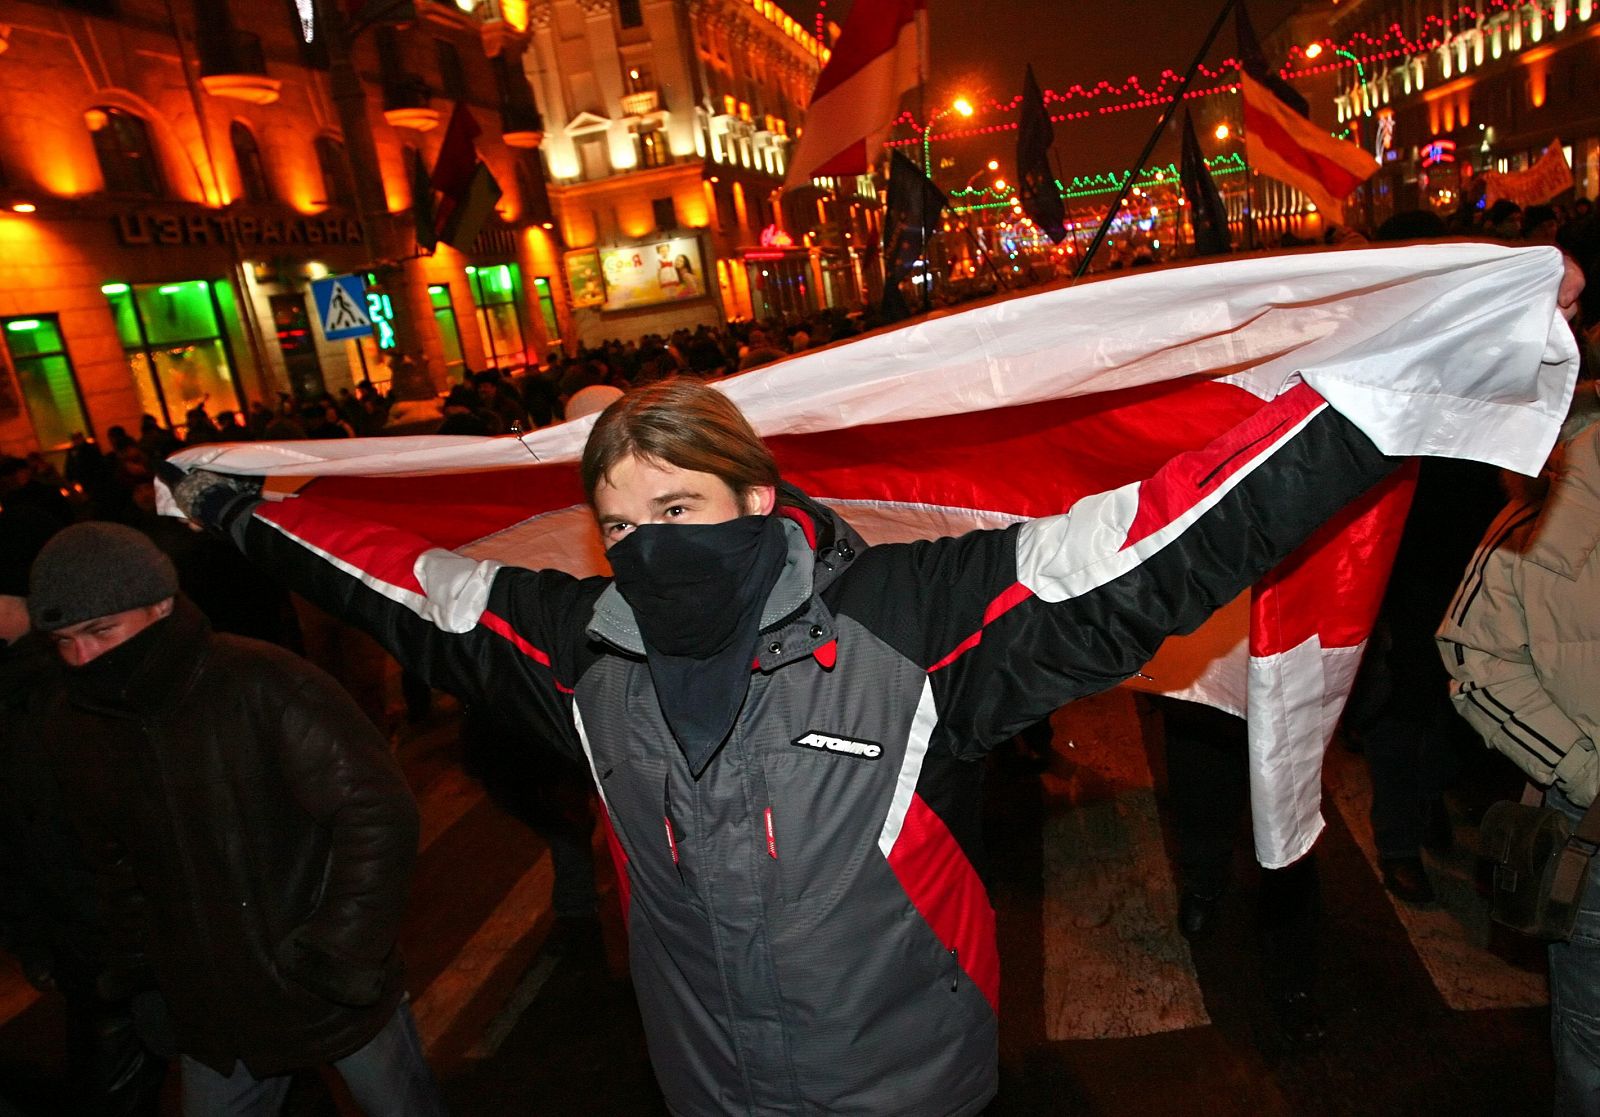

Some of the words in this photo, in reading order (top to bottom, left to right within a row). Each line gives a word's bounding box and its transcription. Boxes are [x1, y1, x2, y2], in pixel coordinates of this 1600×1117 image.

[117, 212, 364, 246] ЦЭНТРАЛЬНА
[366, 293, 394, 323] 21
[797, 733, 882, 758] ATOMIC
